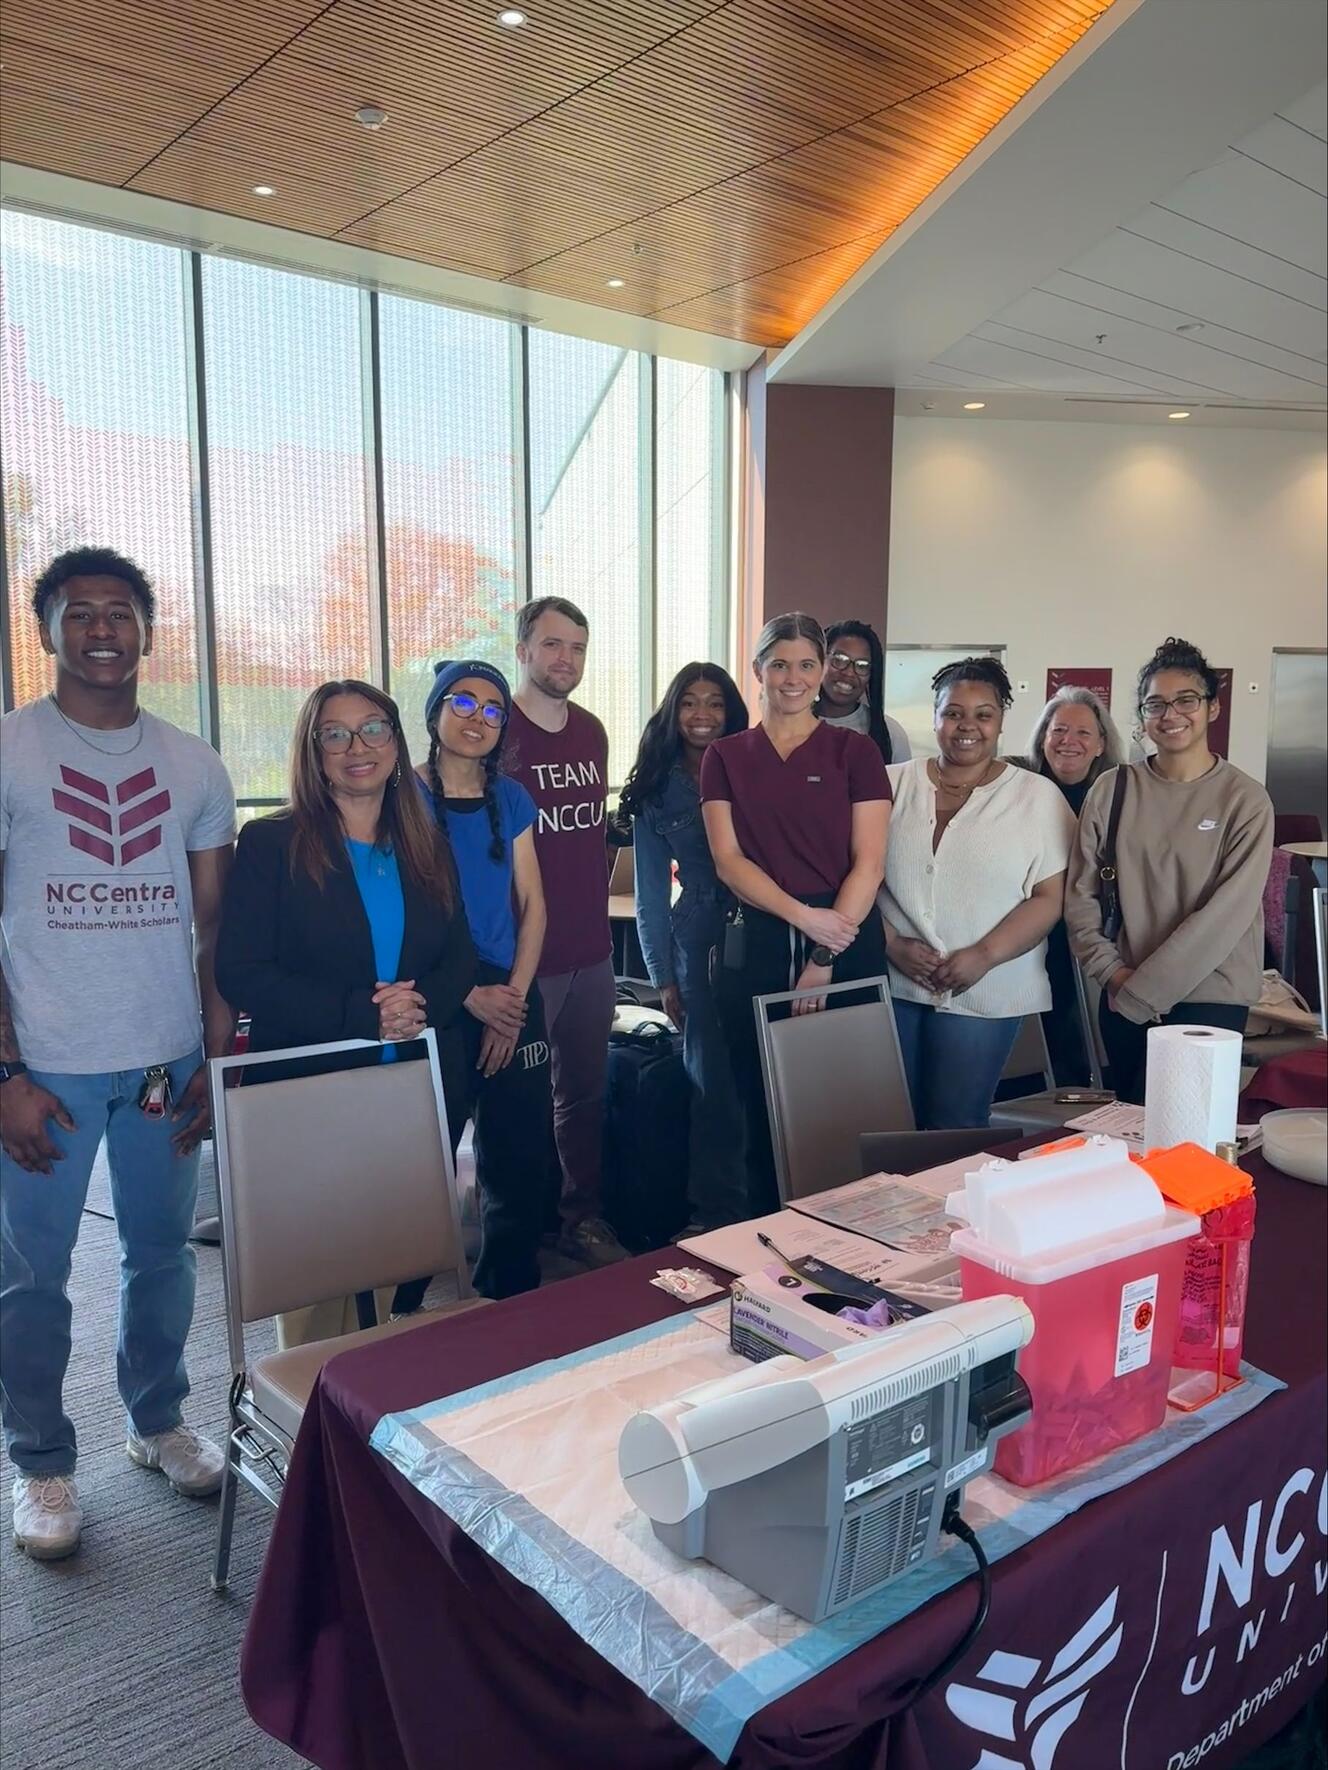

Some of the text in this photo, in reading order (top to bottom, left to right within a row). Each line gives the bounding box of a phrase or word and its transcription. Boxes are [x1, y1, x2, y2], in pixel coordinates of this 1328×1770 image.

[530, 760, 601, 790] TEAM
[538, 800, 604, 834] NCCU
[47, 902, 179, 916] UNIVERSITY
[140, 916, 180, 929] Scholars
[1194, 1467, 1327, 1637] NC
[1167, 1653, 1303, 1769] Department
